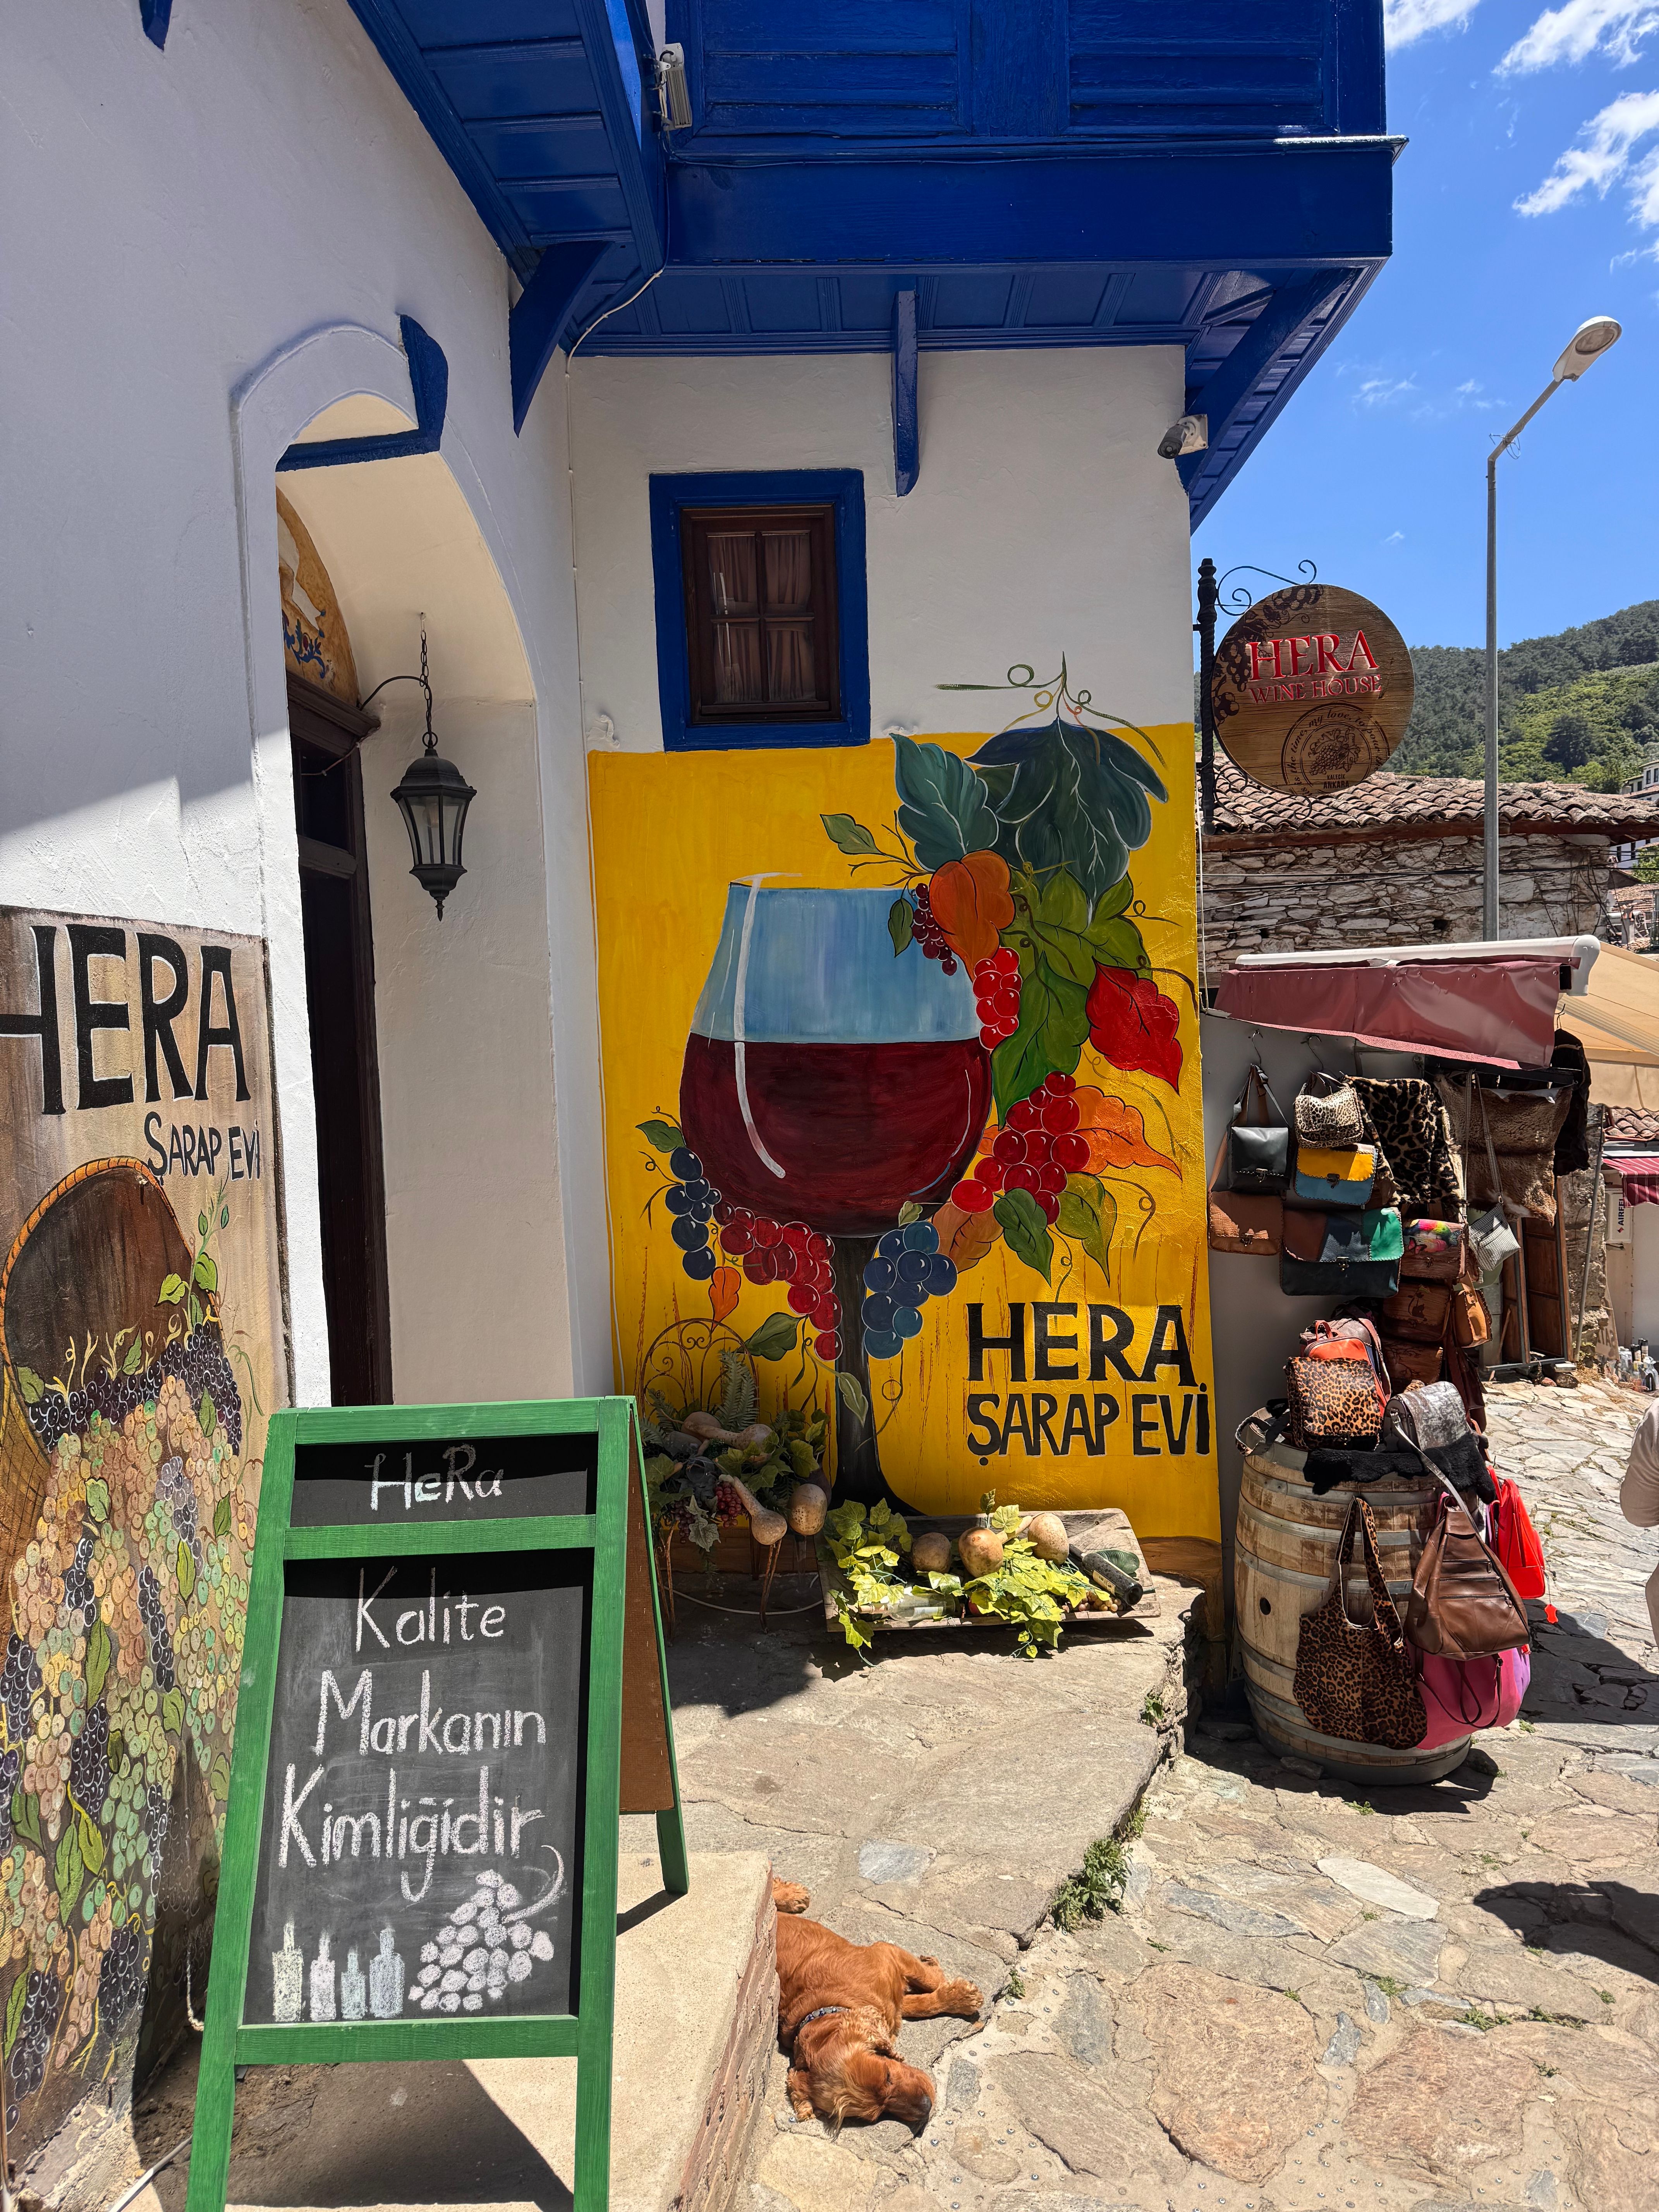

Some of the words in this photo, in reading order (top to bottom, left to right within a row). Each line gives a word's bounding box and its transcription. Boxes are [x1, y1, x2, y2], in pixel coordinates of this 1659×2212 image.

[1245, 630, 1379, 682] HERA
[1249, 682, 1306, 704] WINE
[1312, 675, 1382, 697] HOUSE
[1309, 715, 1323, 728] my
[1327, 709, 1351, 720] love,
[1323, 780, 1349, 789] ANKARA
[144, 1111, 222, 1186] ŞARAP
[227, 1119, 260, 1180] EVİ
[966, 1302, 1199, 1387] HERA
[967, 1393, 1120, 1466] ŞARAP
[1132, 1382, 1210, 1456] EVİ
[355, 1566, 507, 1652] Kalite
[311, 1669, 546, 1757] Markanın
[278, 1762, 545, 1903] Kimliğidir
